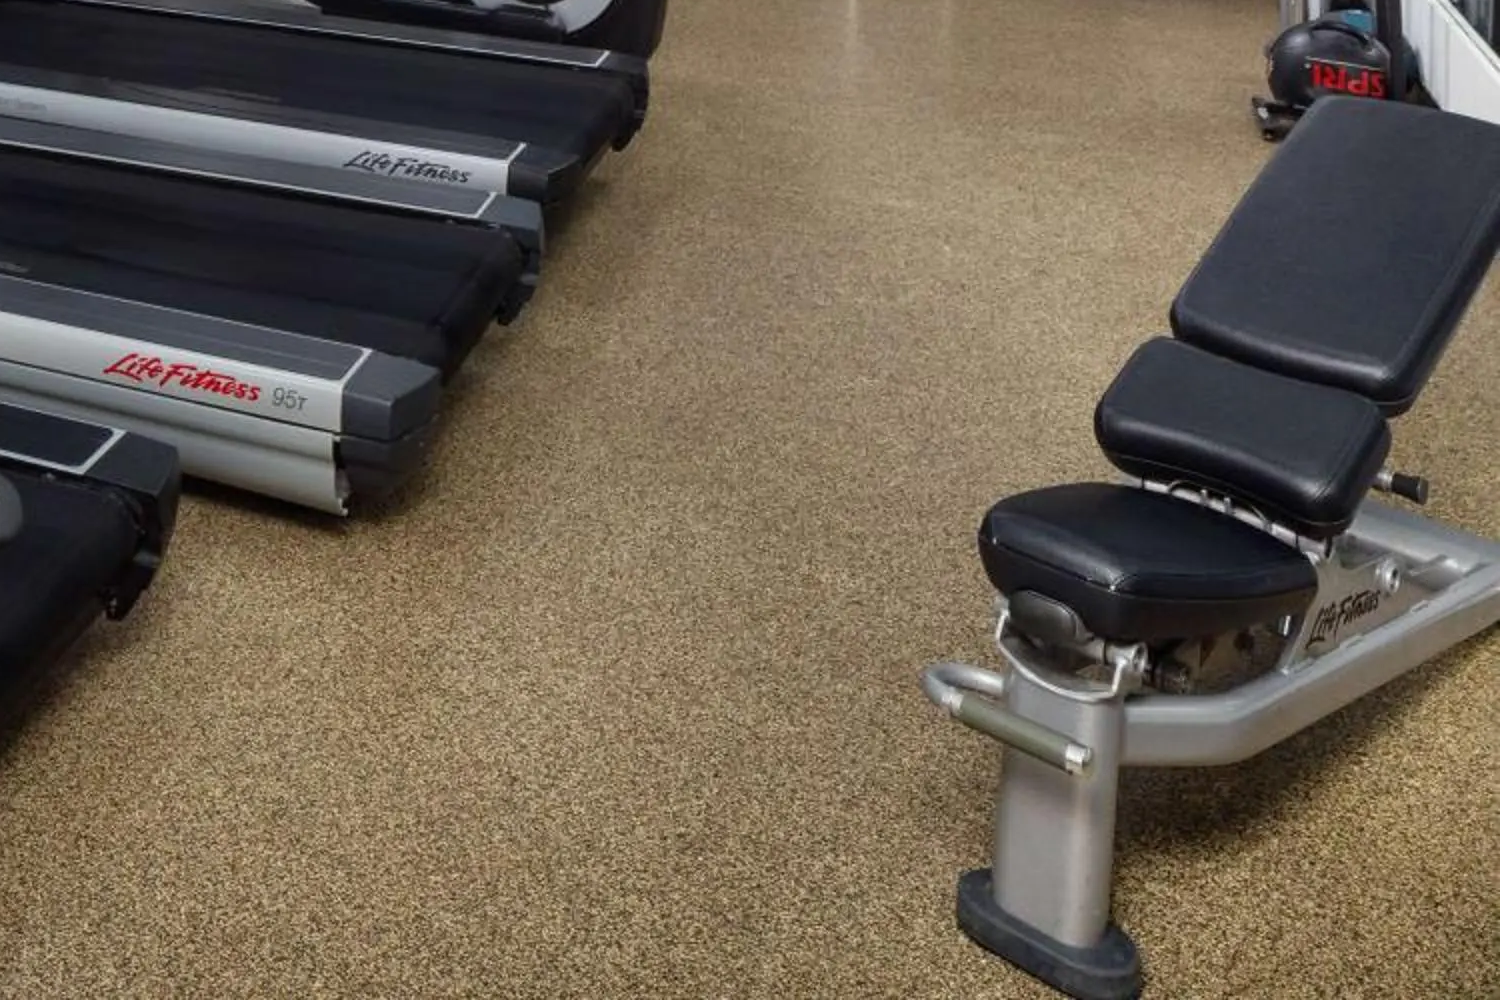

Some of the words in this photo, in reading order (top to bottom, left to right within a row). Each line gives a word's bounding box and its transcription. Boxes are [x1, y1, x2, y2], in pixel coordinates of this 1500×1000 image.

[1311, 62, 1385, 100] SPRI
[388, 158, 473, 183] Fitness
[103, 353, 164, 382] Life
[159, 363, 261, 402] Fitness
[1333, 589, 1381, 641] Fitness
